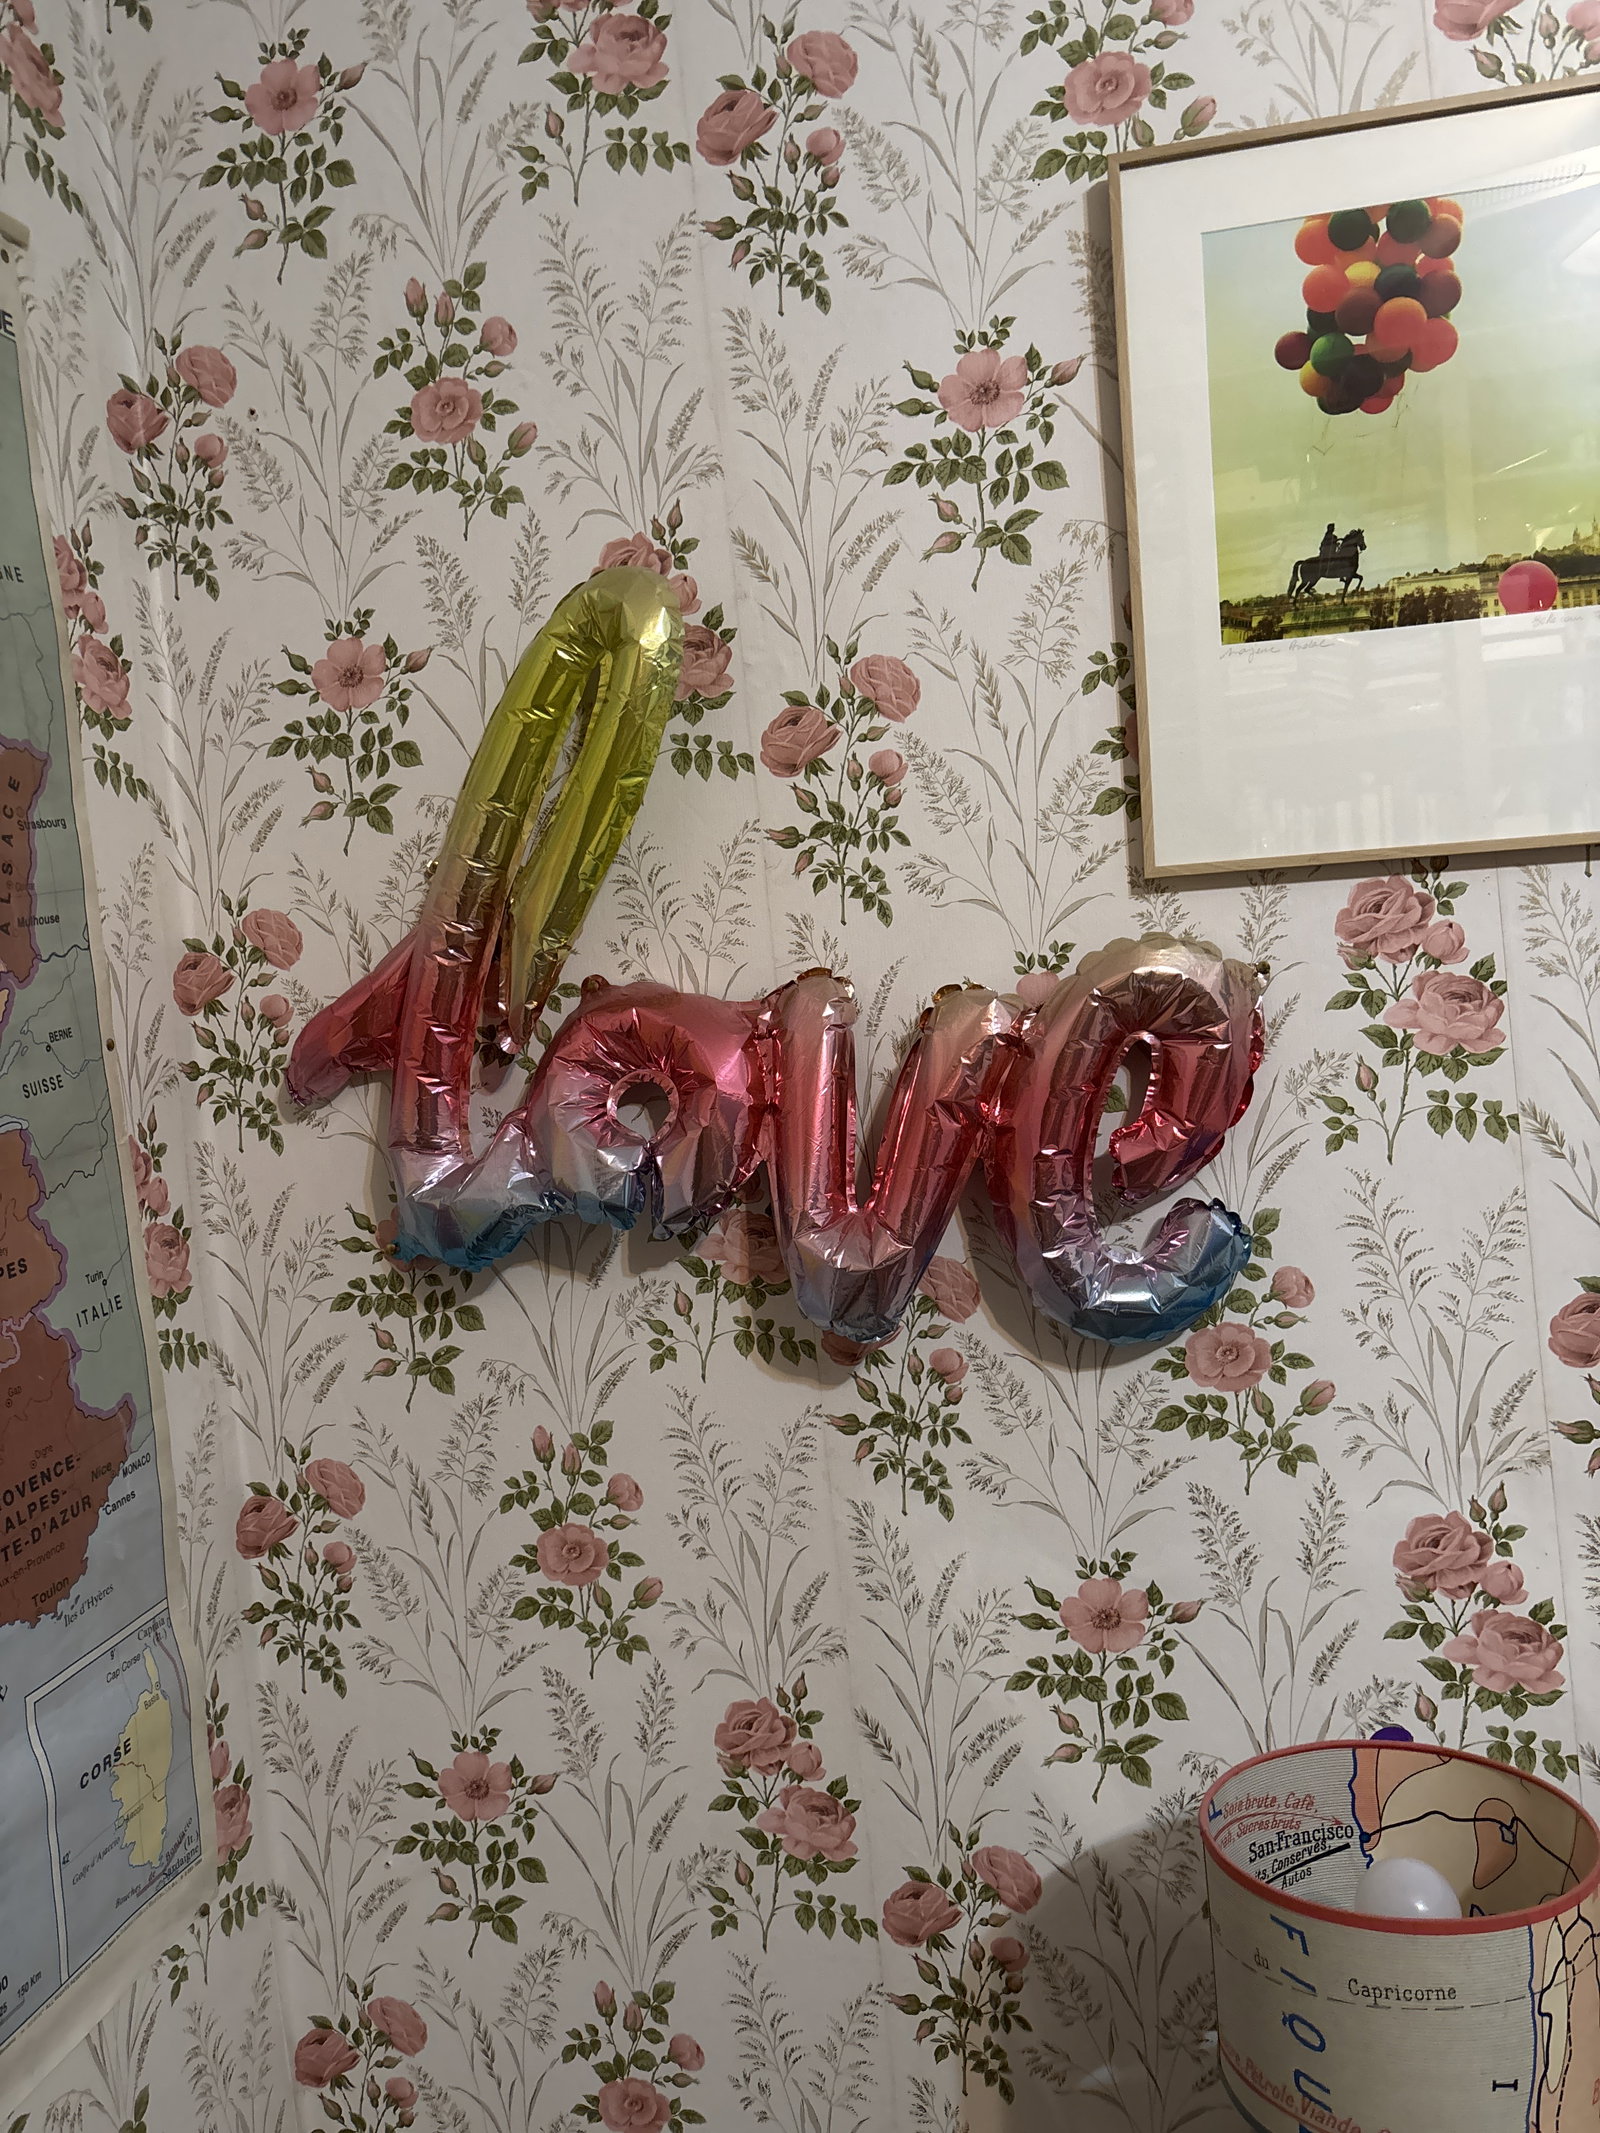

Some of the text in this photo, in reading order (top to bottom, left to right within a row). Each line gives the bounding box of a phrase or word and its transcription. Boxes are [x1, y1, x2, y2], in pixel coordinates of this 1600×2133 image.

[17, 817, 67, 831] Strasbourg
[17, 914, 60, 929] Mulhouse
[49, 1027, 73, 1043] BERNE
[22, 1074, 64, 1099] SUISSE
[85, 1270, 104, 1285] Turin
[76, 1294, 123, 1328] ITALIE
[90, 1462, 112, 1482] Nice
[121, 1452, 151, 1478] MONACO
[0, 1454, 81, 1511] OVENCE-
[104, 1490, 136, 1516] Cannes
[31, 1577, 70, 1609] Toulon
[79, 1583, 114, 1616] d'Hyères
[106, 1652, 141, 1684] Cap Corse
[79, 1738, 132, 1790] CORSE
[1249, 1823, 1354, 1864] San-Francisco
[1271, 1839, 1332, 1875] Conserves,
[1281, 1866, 1312, 1890] Autos
[1254, 1948, 1457, 2005] du Capricorne
